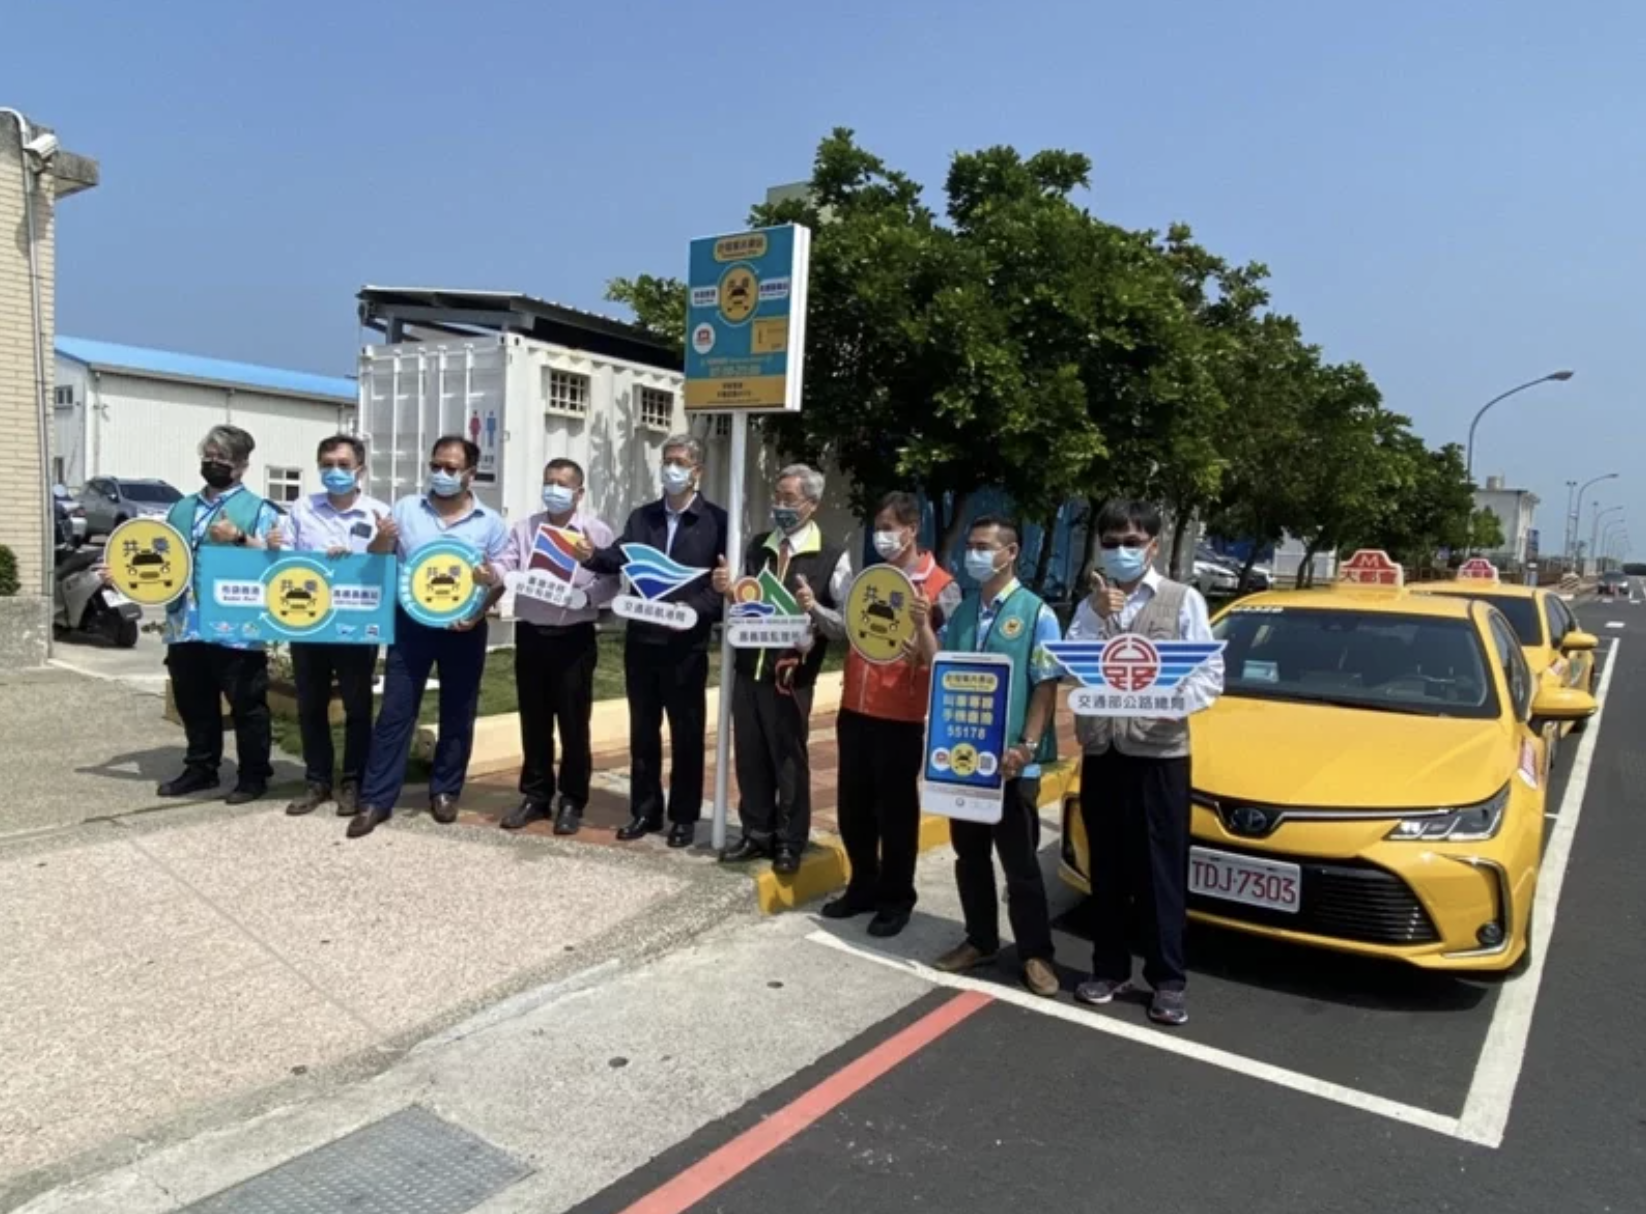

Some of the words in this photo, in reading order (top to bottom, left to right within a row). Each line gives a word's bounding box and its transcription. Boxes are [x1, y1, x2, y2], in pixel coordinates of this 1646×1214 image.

[1359, 554, 1380, 567] M
[1078, 694, 1184, 711] 交通部公路總局
